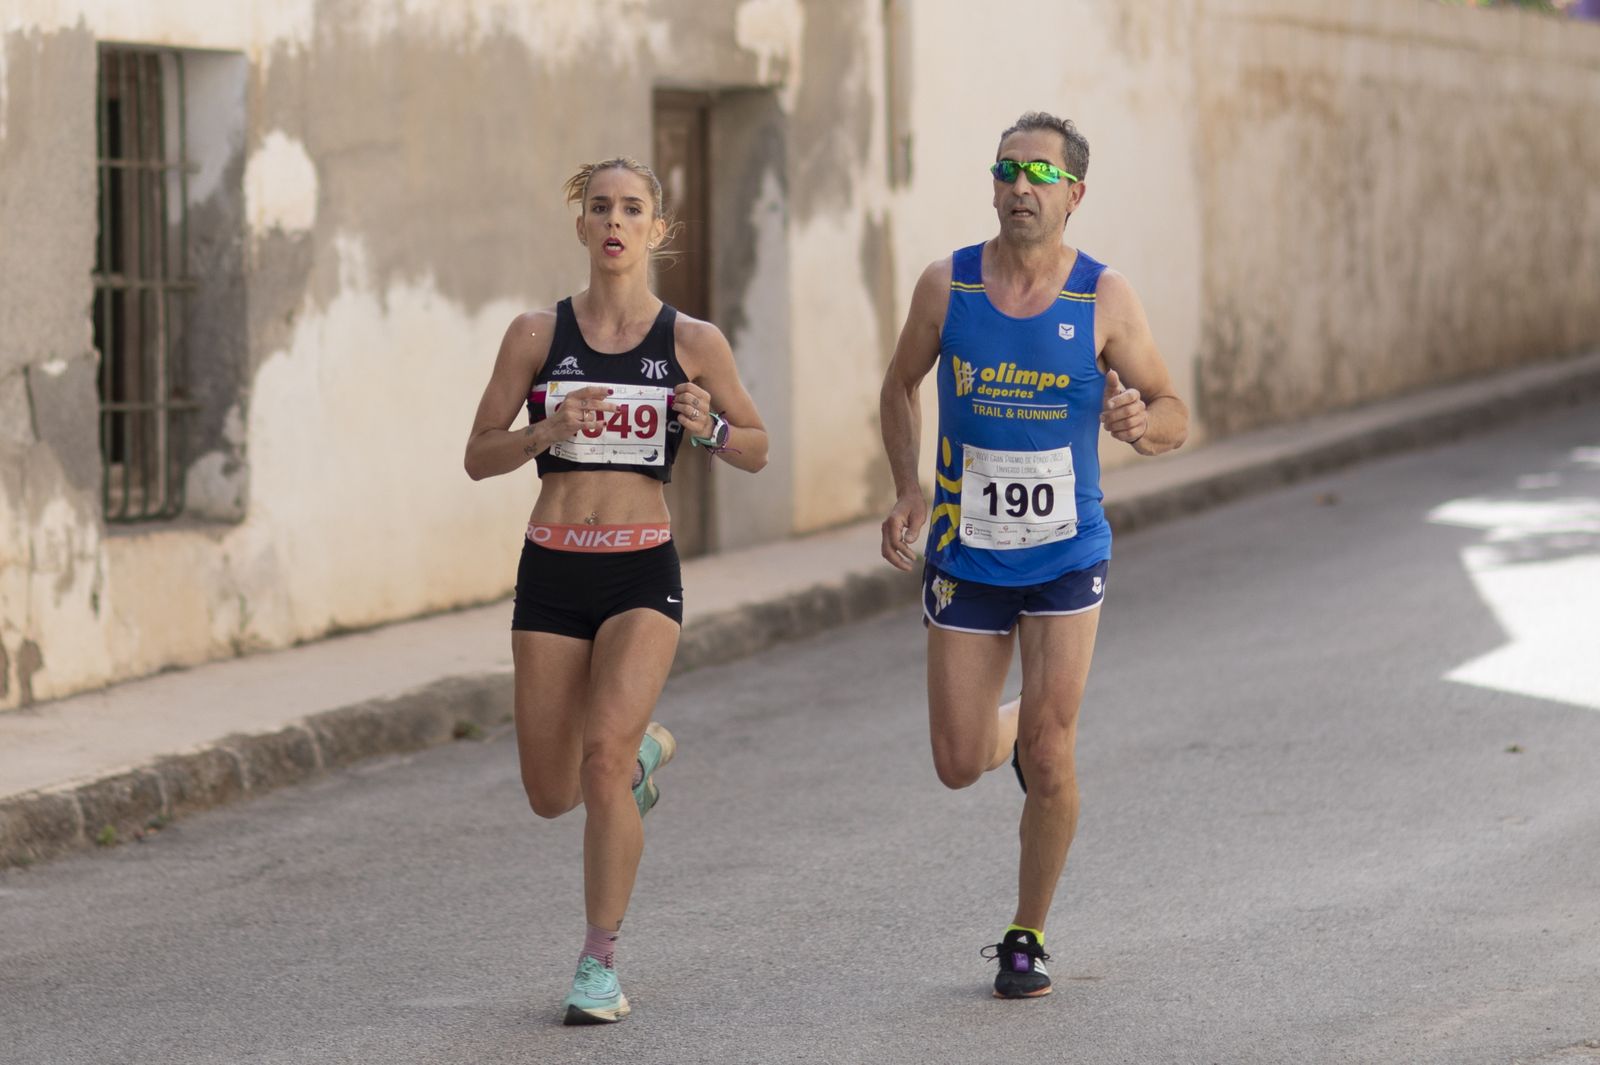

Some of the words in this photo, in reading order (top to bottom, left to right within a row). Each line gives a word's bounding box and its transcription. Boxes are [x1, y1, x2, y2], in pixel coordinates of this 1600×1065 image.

[980, 362, 1070, 391] olimpo
[977, 384, 1034, 399] deportes
[554, 402, 659, 439] 049
[973, 404, 1003, 417] TRAIL
[1005, 407, 1014, 418] &
[1017, 408, 1067, 420] RUNNING
[983, 482, 1054, 518] 190
[563, 529, 634, 547] NIKE
